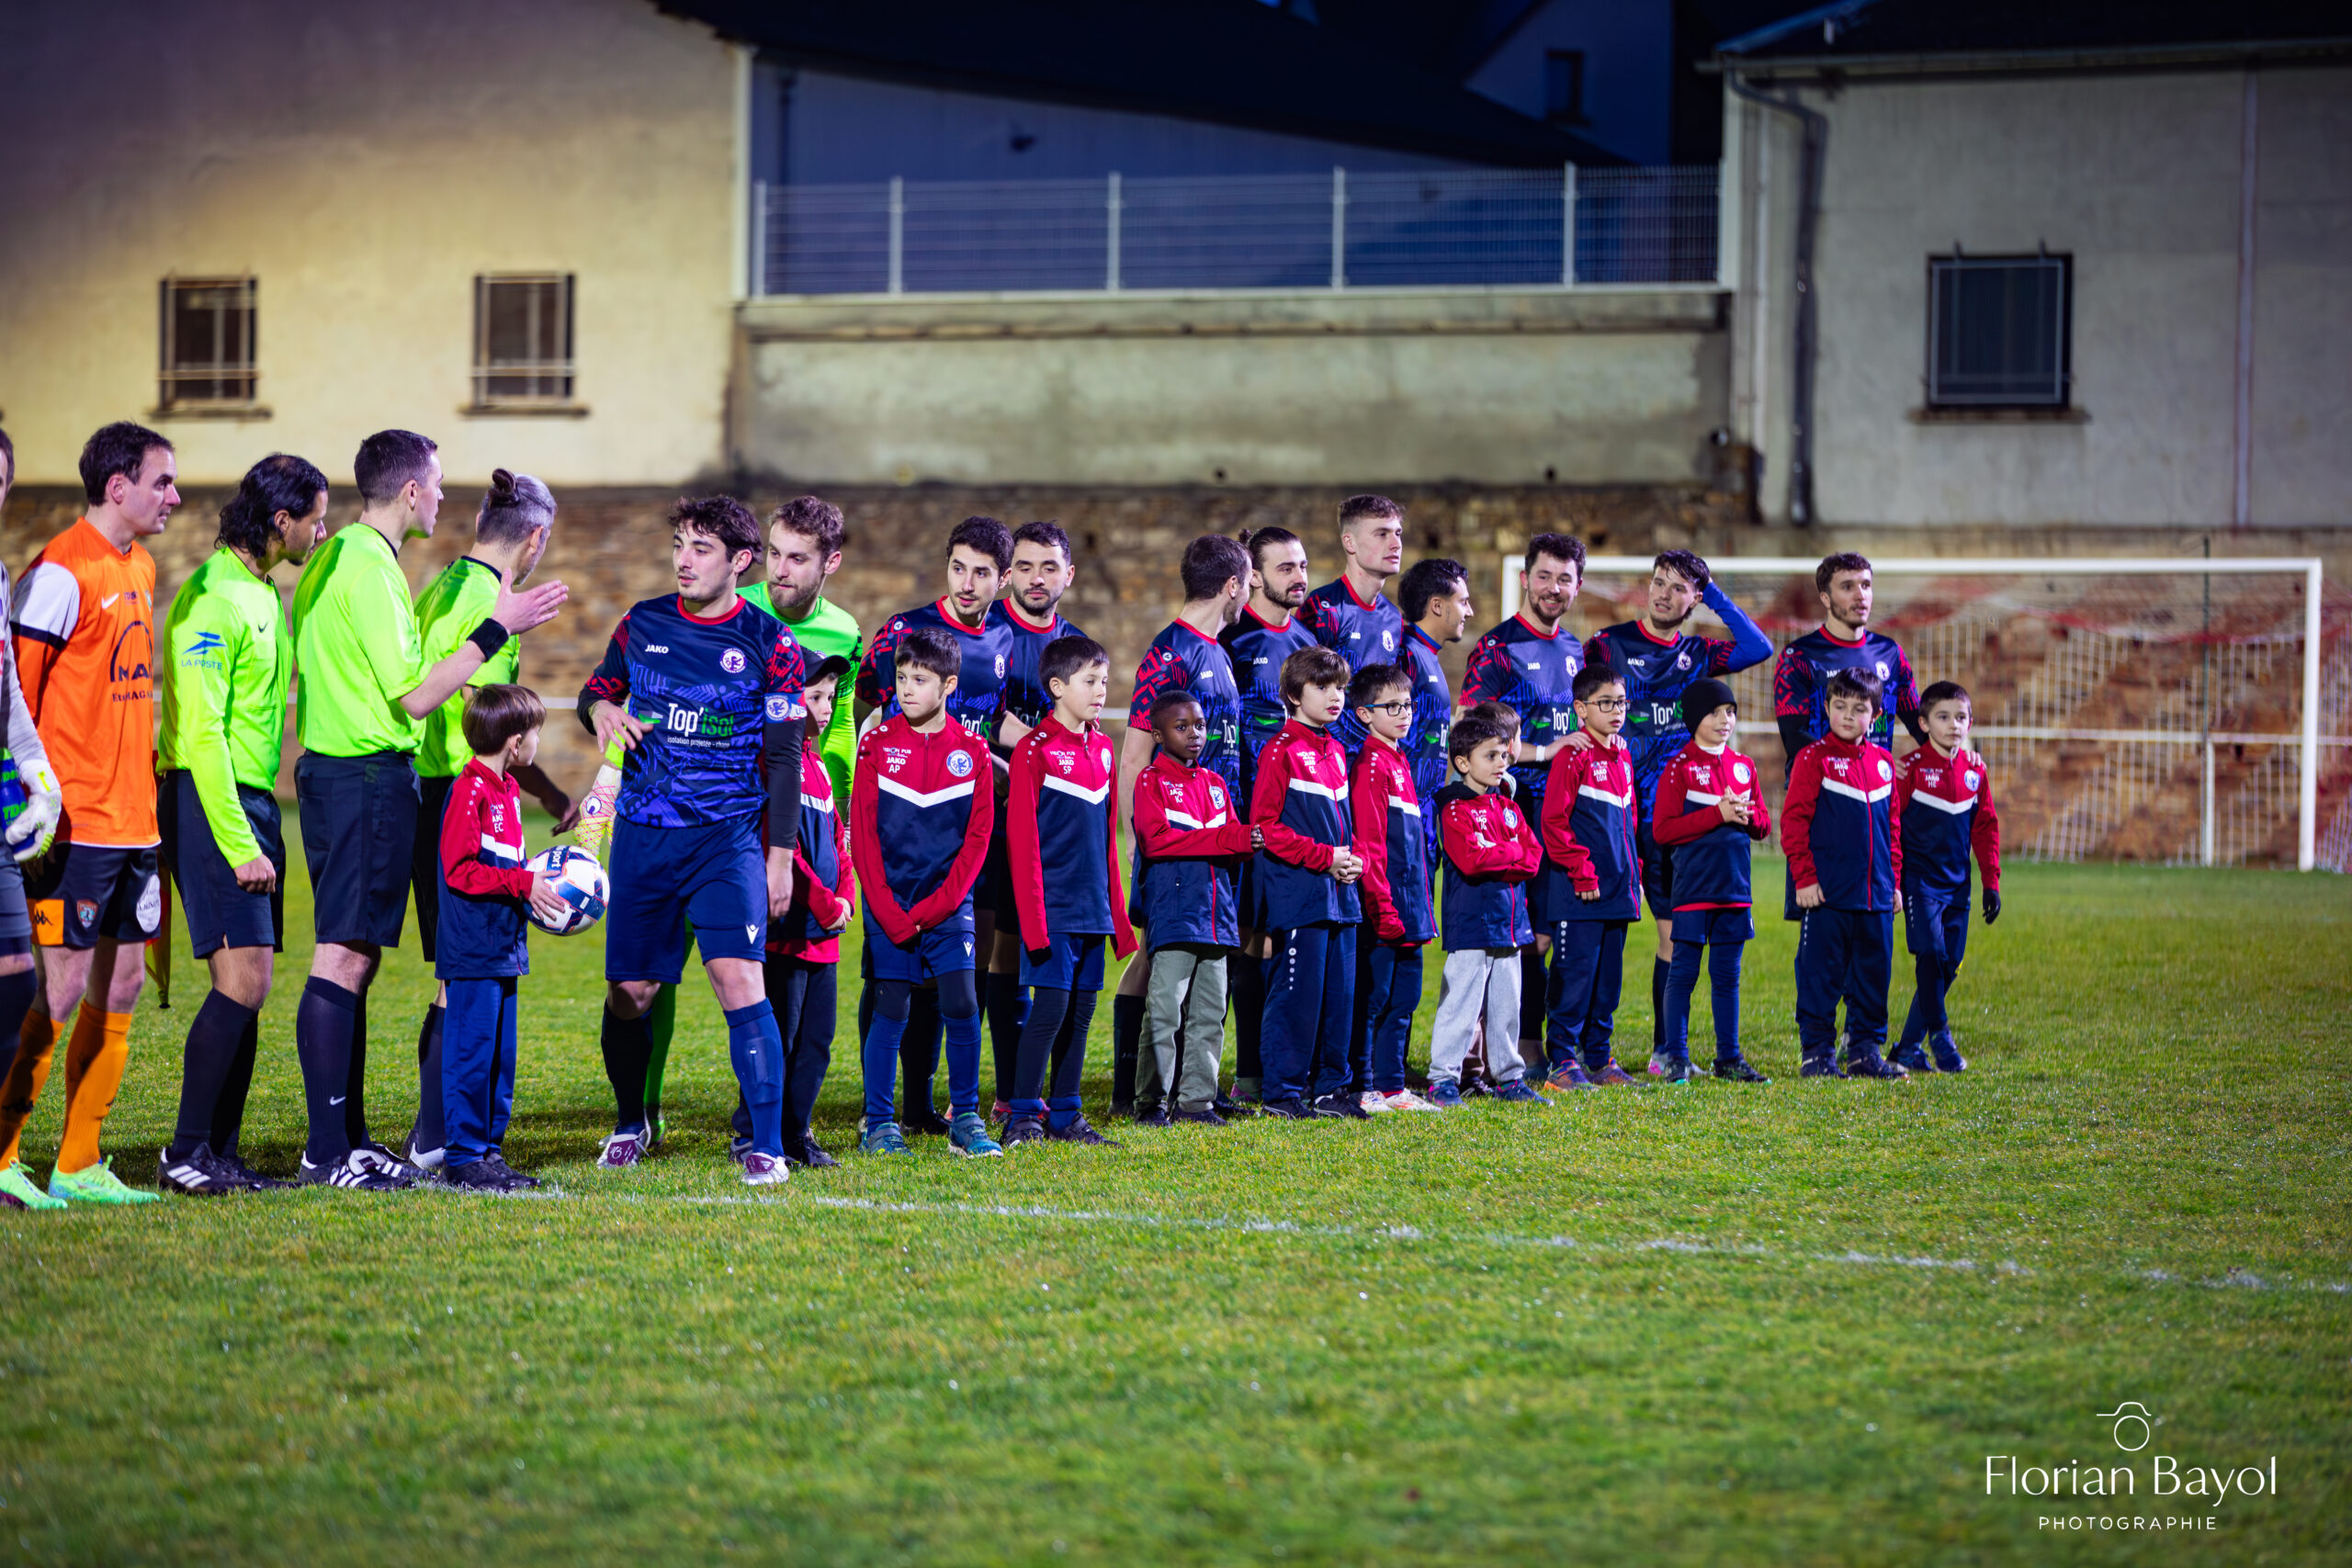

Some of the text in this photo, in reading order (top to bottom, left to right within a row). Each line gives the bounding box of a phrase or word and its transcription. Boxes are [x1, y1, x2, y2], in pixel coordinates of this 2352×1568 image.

[645, 644, 669, 654] JAKO
[181, 660, 223, 671] LA POSTE
[667, 703, 734, 738] Top'isol
[667, 735, 689, 745] isolation
[886, 757, 906, 765] JAKO
[888, 763, 900, 773] AP
[1063, 765, 1072, 774] SP
[493, 822, 503, 833] EC
